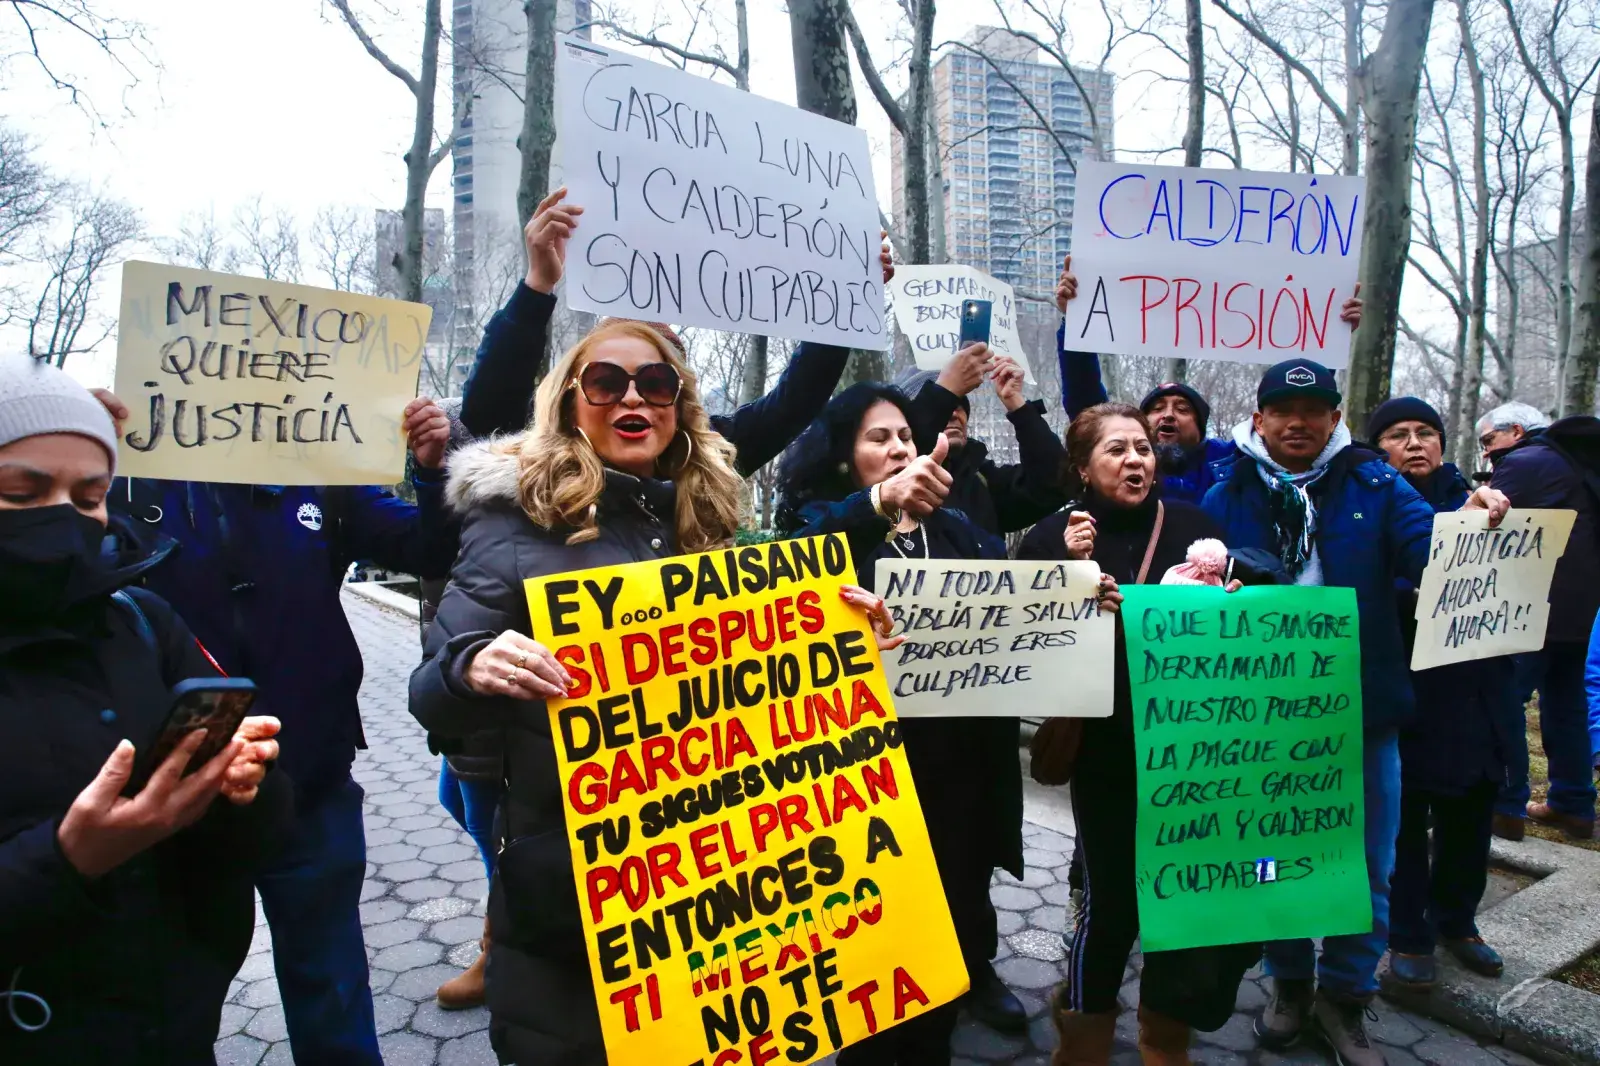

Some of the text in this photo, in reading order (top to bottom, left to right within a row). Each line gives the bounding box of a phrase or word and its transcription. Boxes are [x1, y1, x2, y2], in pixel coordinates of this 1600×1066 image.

[583, 64, 866, 199] GARCIA LUNA
[598, 151, 869, 276] Y CALDERÓN
[1099, 174, 1358, 256] CALDERÓN
[167, 281, 367, 343] MEXICO
[582, 233, 882, 335] SON CULPABLES
[1081, 274, 1336, 351] A PRISIÓN
[661, 533, 847, 612] PAISANO
[885, 564, 1067, 599] NI TODA LA
[1431, 568, 1498, 619] AHORA
[554, 590, 825, 699] SI DESPUES
[898, 630, 1077, 666] BOROLAS ERES
[980, 604, 1012, 630] TE
[1023, 597, 1101, 624] SALVA
[1142, 607, 1352, 644] QUE LA SANGRE
[558, 630, 874, 762] DEL JUICIO DE
[894, 663, 1032, 697] CULPABLE
[1139, 650, 1337, 684] DERRAMADA DE
[568, 680, 887, 815] GARCIA LUNA
[1144, 693, 1350, 730] NUESTRO PUEBLO
[1146, 732, 1347, 771] LA PAGUE CON
[576, 721, 904, 864] TU SIGUES VOTANDO
[1151, 777, 1252, 807] CARCEL
[1155, 802, 1354, 846] LUNA Y CALDERON
[586, 757, 899, 924] POR EL PRIAN
[597, 816, 903, 984] ENTONCES A
[610, 877, 883, 1033] TI MEXICO
[701, 948, 843, 1053] NO TE
